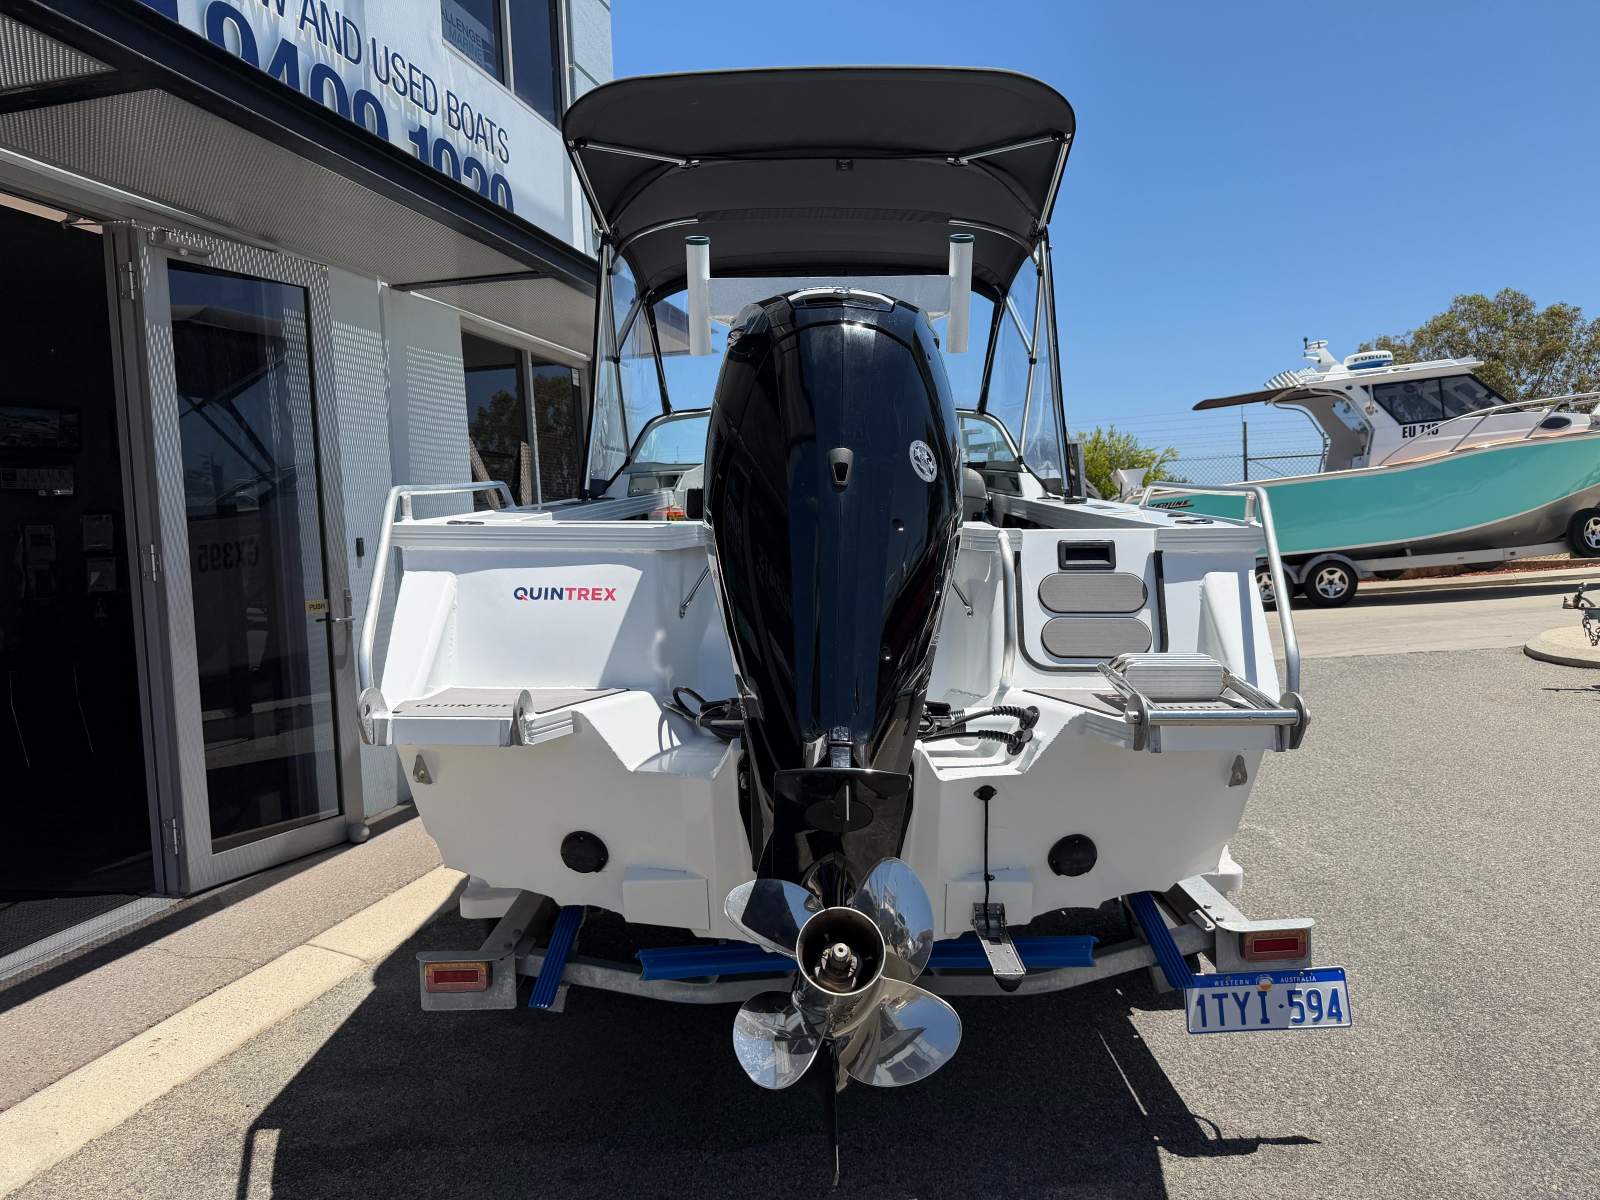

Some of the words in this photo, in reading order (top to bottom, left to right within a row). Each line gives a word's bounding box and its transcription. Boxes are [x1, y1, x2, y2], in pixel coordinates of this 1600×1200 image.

[299, 0, 362, 65] AND
[372, 37, 438, 116] USED
[446, 89, 510, 164] BOATS
[1402, 425, 1416, 438] EU
[513, 586, 617, 602] QUINTREX
[1214, 979, 1250, 987] WESTERN
[1280, 975, 1317, 984] AUSTRALIA
